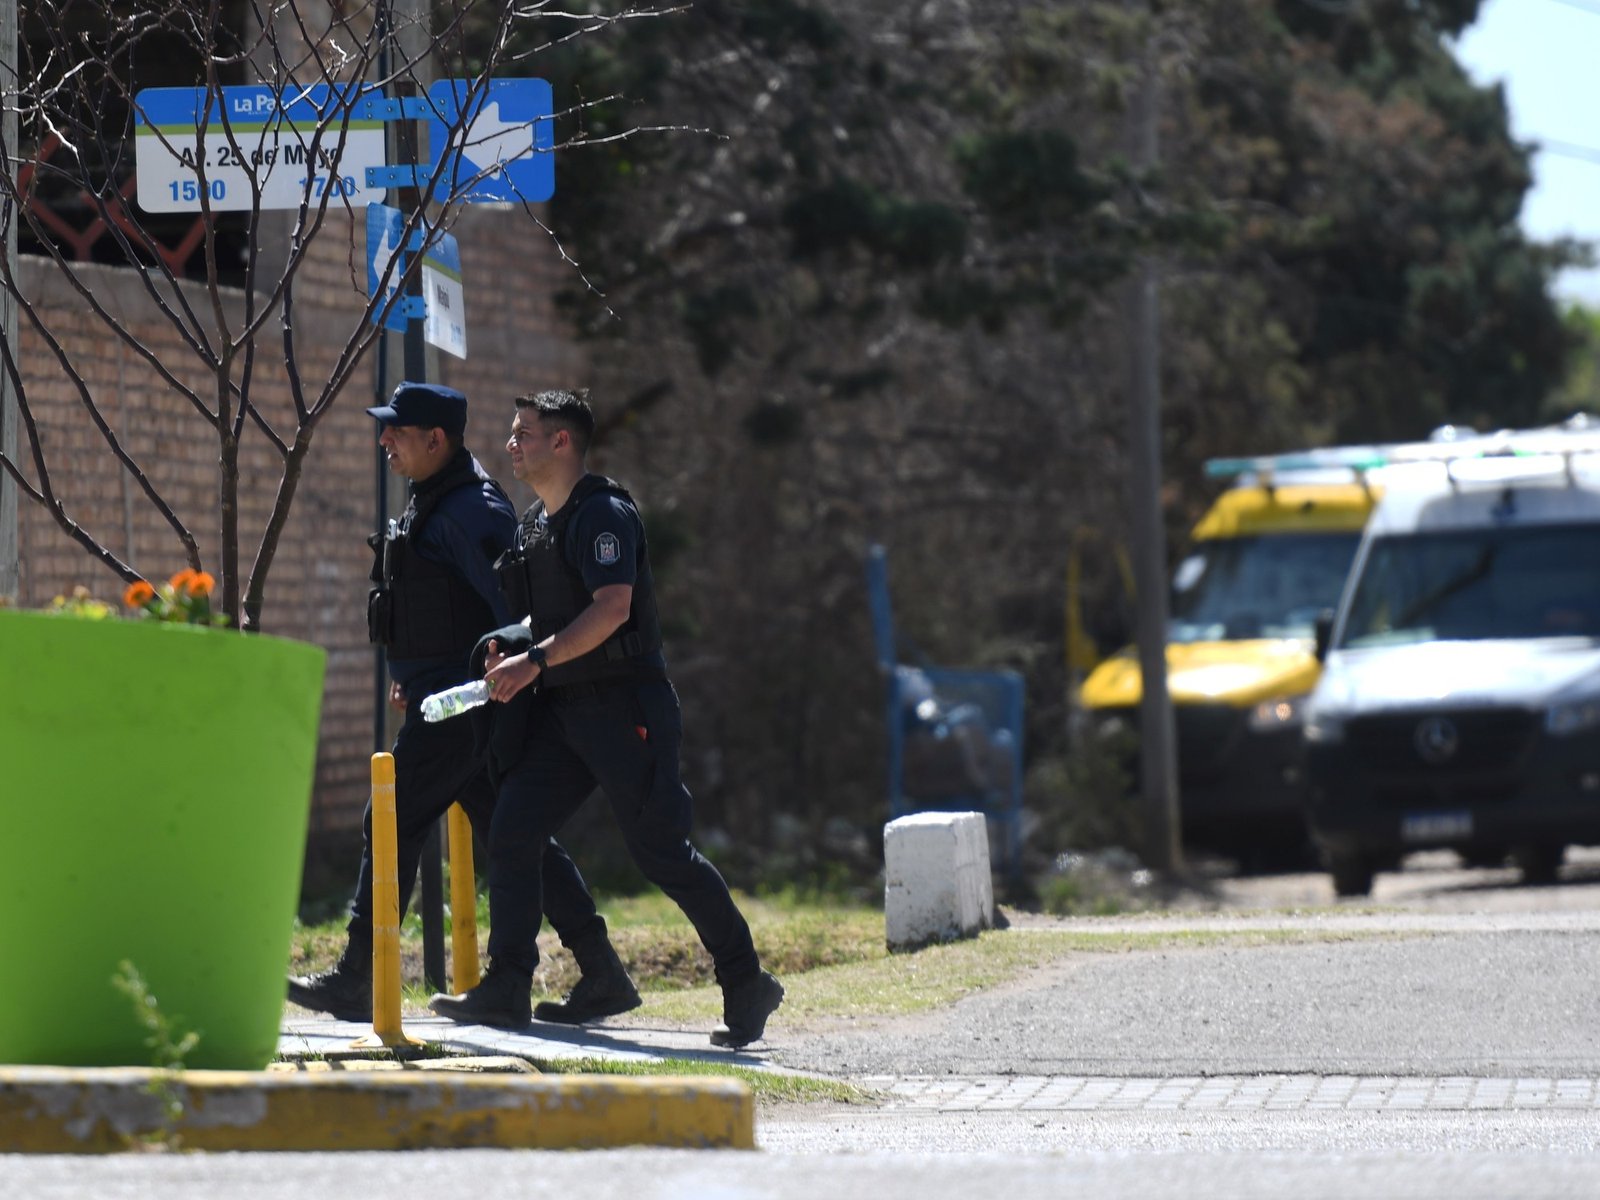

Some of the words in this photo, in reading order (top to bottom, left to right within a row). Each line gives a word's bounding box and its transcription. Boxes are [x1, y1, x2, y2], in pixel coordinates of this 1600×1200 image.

[234, 98, 253, 112] La
[256, 94, 285, 112] Pa
[180, 147, 211, 167] A.
[284, 144, 341, 169] Myo
